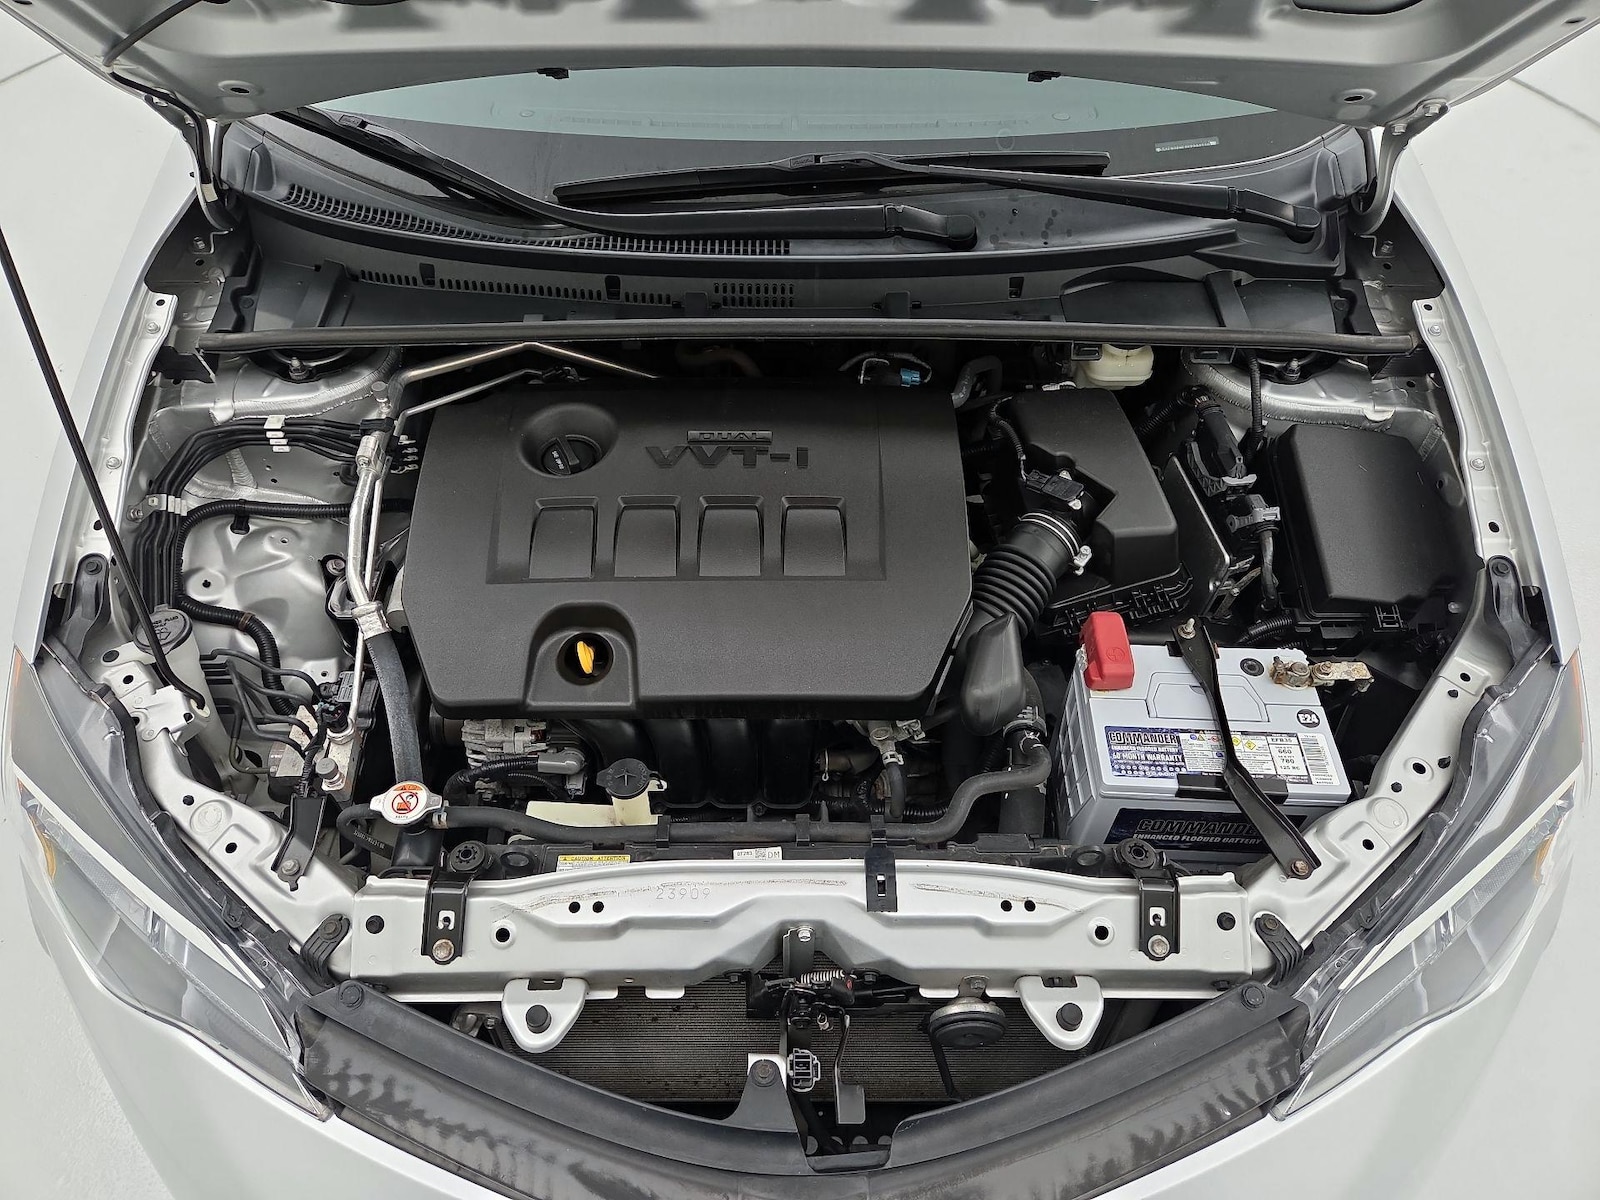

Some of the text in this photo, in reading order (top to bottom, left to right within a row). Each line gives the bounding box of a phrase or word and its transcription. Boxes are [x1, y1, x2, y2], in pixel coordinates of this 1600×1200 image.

[698, 432, 765, 440] DUAL
[1297, 713, 1319, 724] E24
[1108, 732, 1178, 747] COMMANDER
[1122, 753, 1146, 761] MONTH
[1145, 754, 1182, 762] WARRANTY
[1135, 819, 1260, 836] COMMANDE
[1132, 833, 1263, 845] ENHANCED FLOODED BATTERY
[767, 851, 780, 859] DM
[656, 887, 711, 900] 23909
